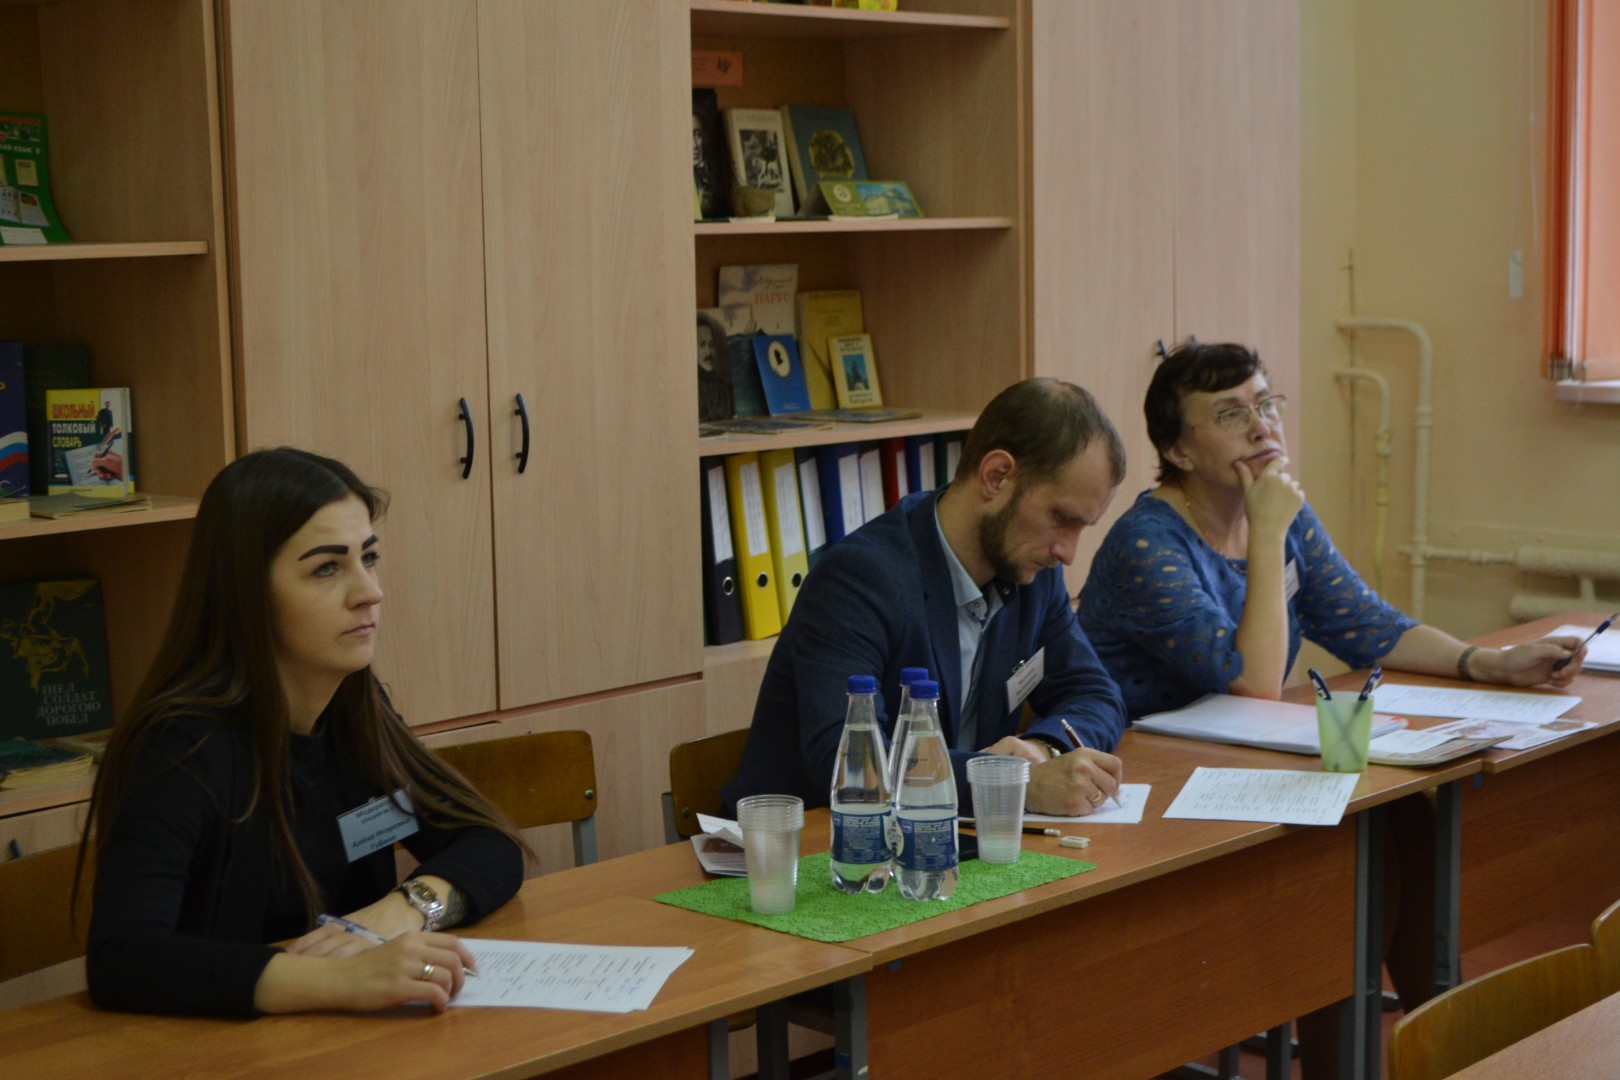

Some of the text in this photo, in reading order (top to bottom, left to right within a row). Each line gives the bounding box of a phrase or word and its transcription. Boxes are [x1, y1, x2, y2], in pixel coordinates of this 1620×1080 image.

[755, 291, 790, 305] ПАРУС
[51, 401, 96, 419] ШКОЛЬНЫЙ
[52, 421, 96, 434] ТОЛКОВЫЙ
[52, 436, 82, 448] СЛОВАРЬ
[44, 691, 97, 704] СОЛДАТ
[36, 701, 101, 717] ДОРОГОЮ
[46, 713, 88, 725] ПОБЕД
